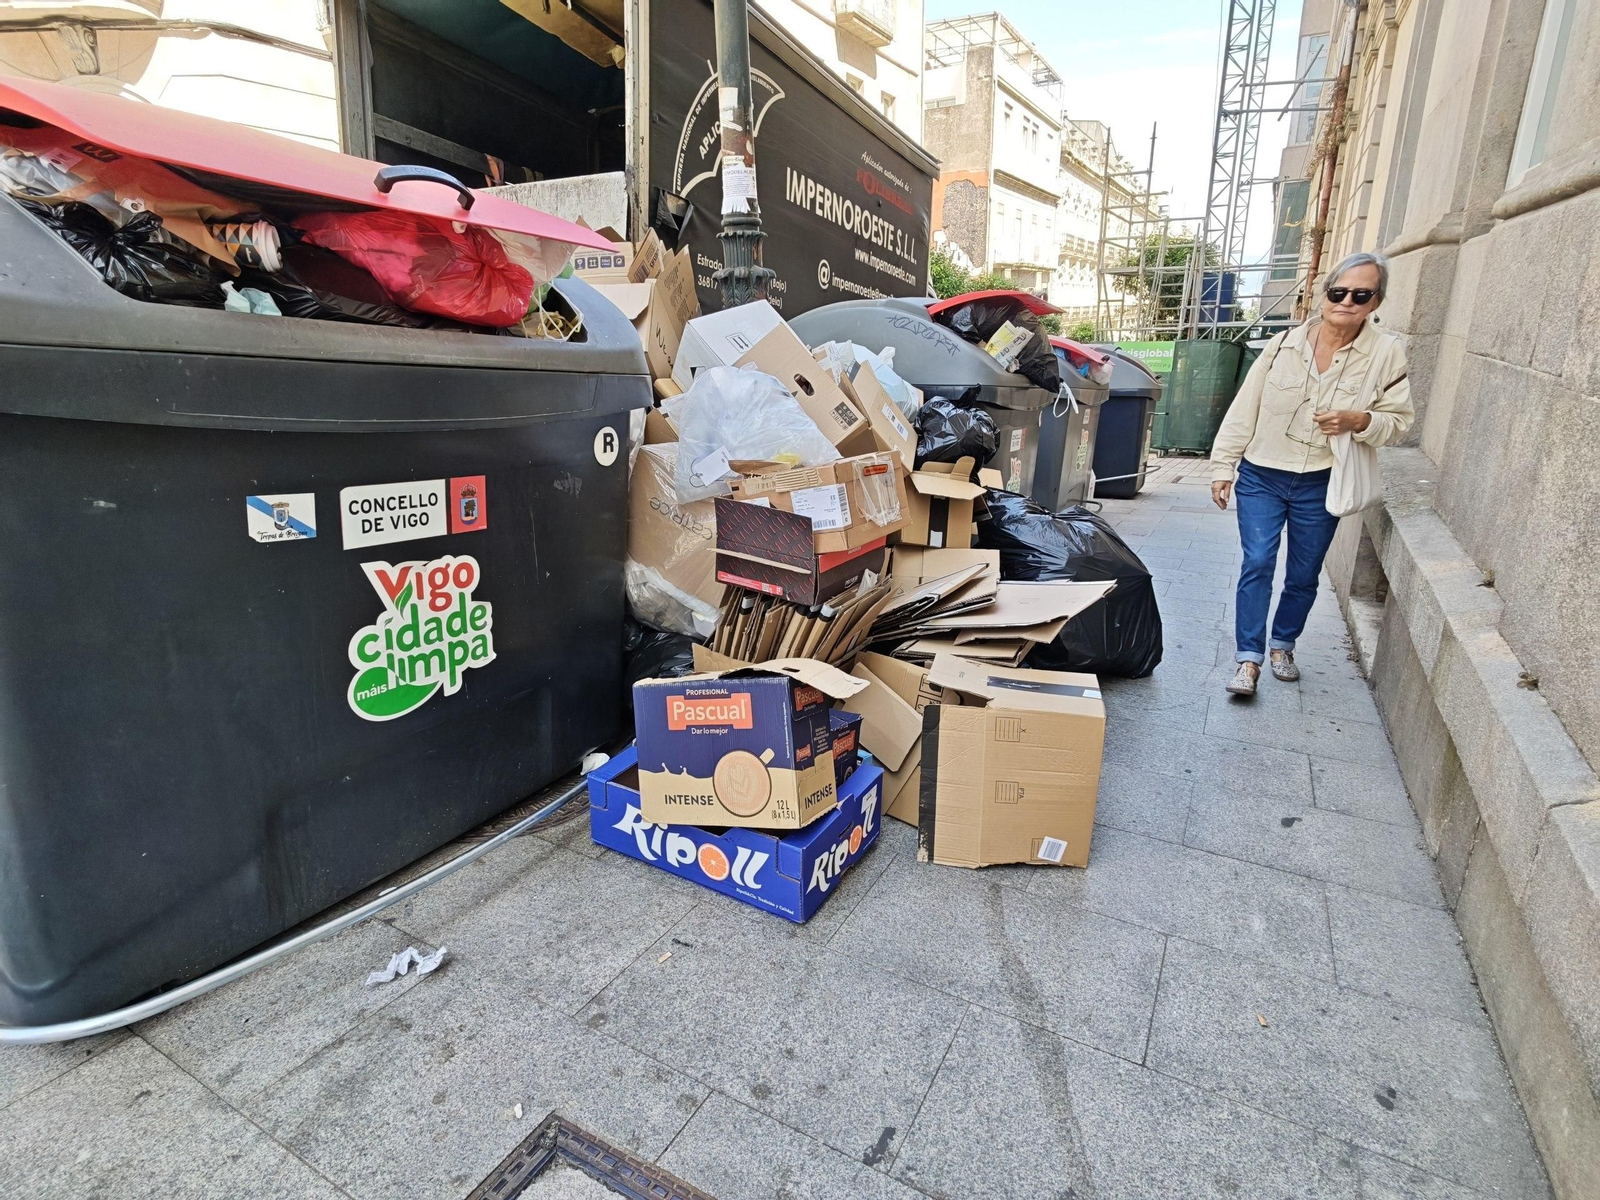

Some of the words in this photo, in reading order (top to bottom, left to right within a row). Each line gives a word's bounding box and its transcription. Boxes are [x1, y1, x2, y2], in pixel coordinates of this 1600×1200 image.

[786, 166, 895, 252] IMPERNOROESTE
[602, 432, 614, 453] R
[348, 492, 438, 515] CONCELLO
[361, 517, 385, 534] DE
[390, 512, 430, 530] VIGO
[374, 562, 475, 613] Vigo
[357, 591, 488, 664] cidade
[356, 683, 388, 701] máis
[386, 634, 489, 691] limpa
[685, 688, 729, 696] PROFESIONAL
[672, 699, 746, 721] Pascual
[691, 727, 703, 735] Dar
[703, 727, 710, 735] lo
[709, 727, 729, 736] mejor
[664, 794, 714, 806] INTENSE
[776, 799, 785, 810] 12
[785, 800, 790, 810] L
[804, 783, 833, 810] INTENSE
[612, 803, 770, 890] Ripoll
[805, 784, 878, 895] Ripoll
